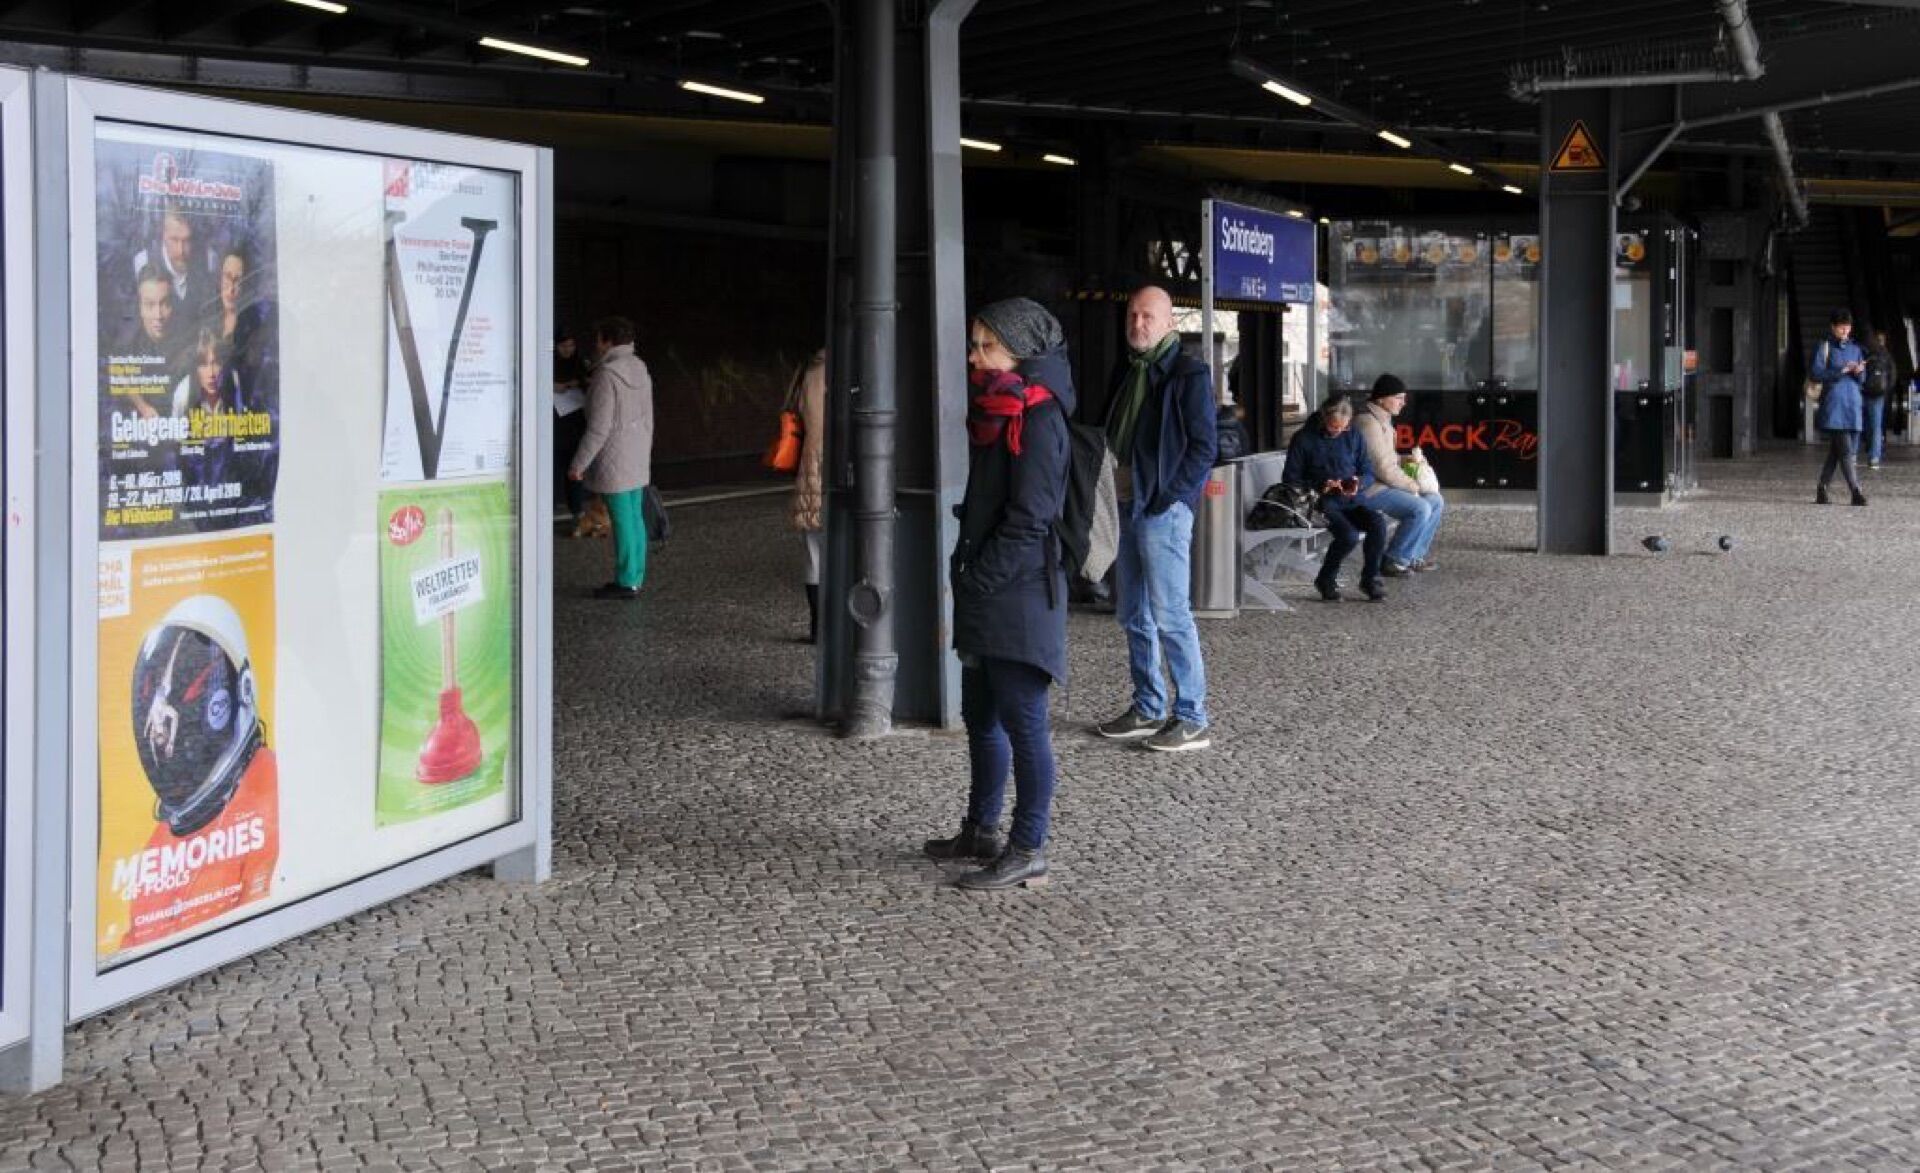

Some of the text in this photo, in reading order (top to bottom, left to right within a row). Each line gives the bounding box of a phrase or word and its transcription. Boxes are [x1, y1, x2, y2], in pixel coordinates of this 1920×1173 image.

[1222, 217, 1274, 265] Schöneberg
[112, 407, 271, 446] Gelogene Wahrheiten
[1396, 423, 1489, 450] BACK
[142, 488, 164, 510] April
[203, 483, 224, 503] April
[415, 558, 480, 599] WELTRETTEN
[111, 817, 265, 893] MEMORIES
[142, 869, 190, 897] FOOLS
